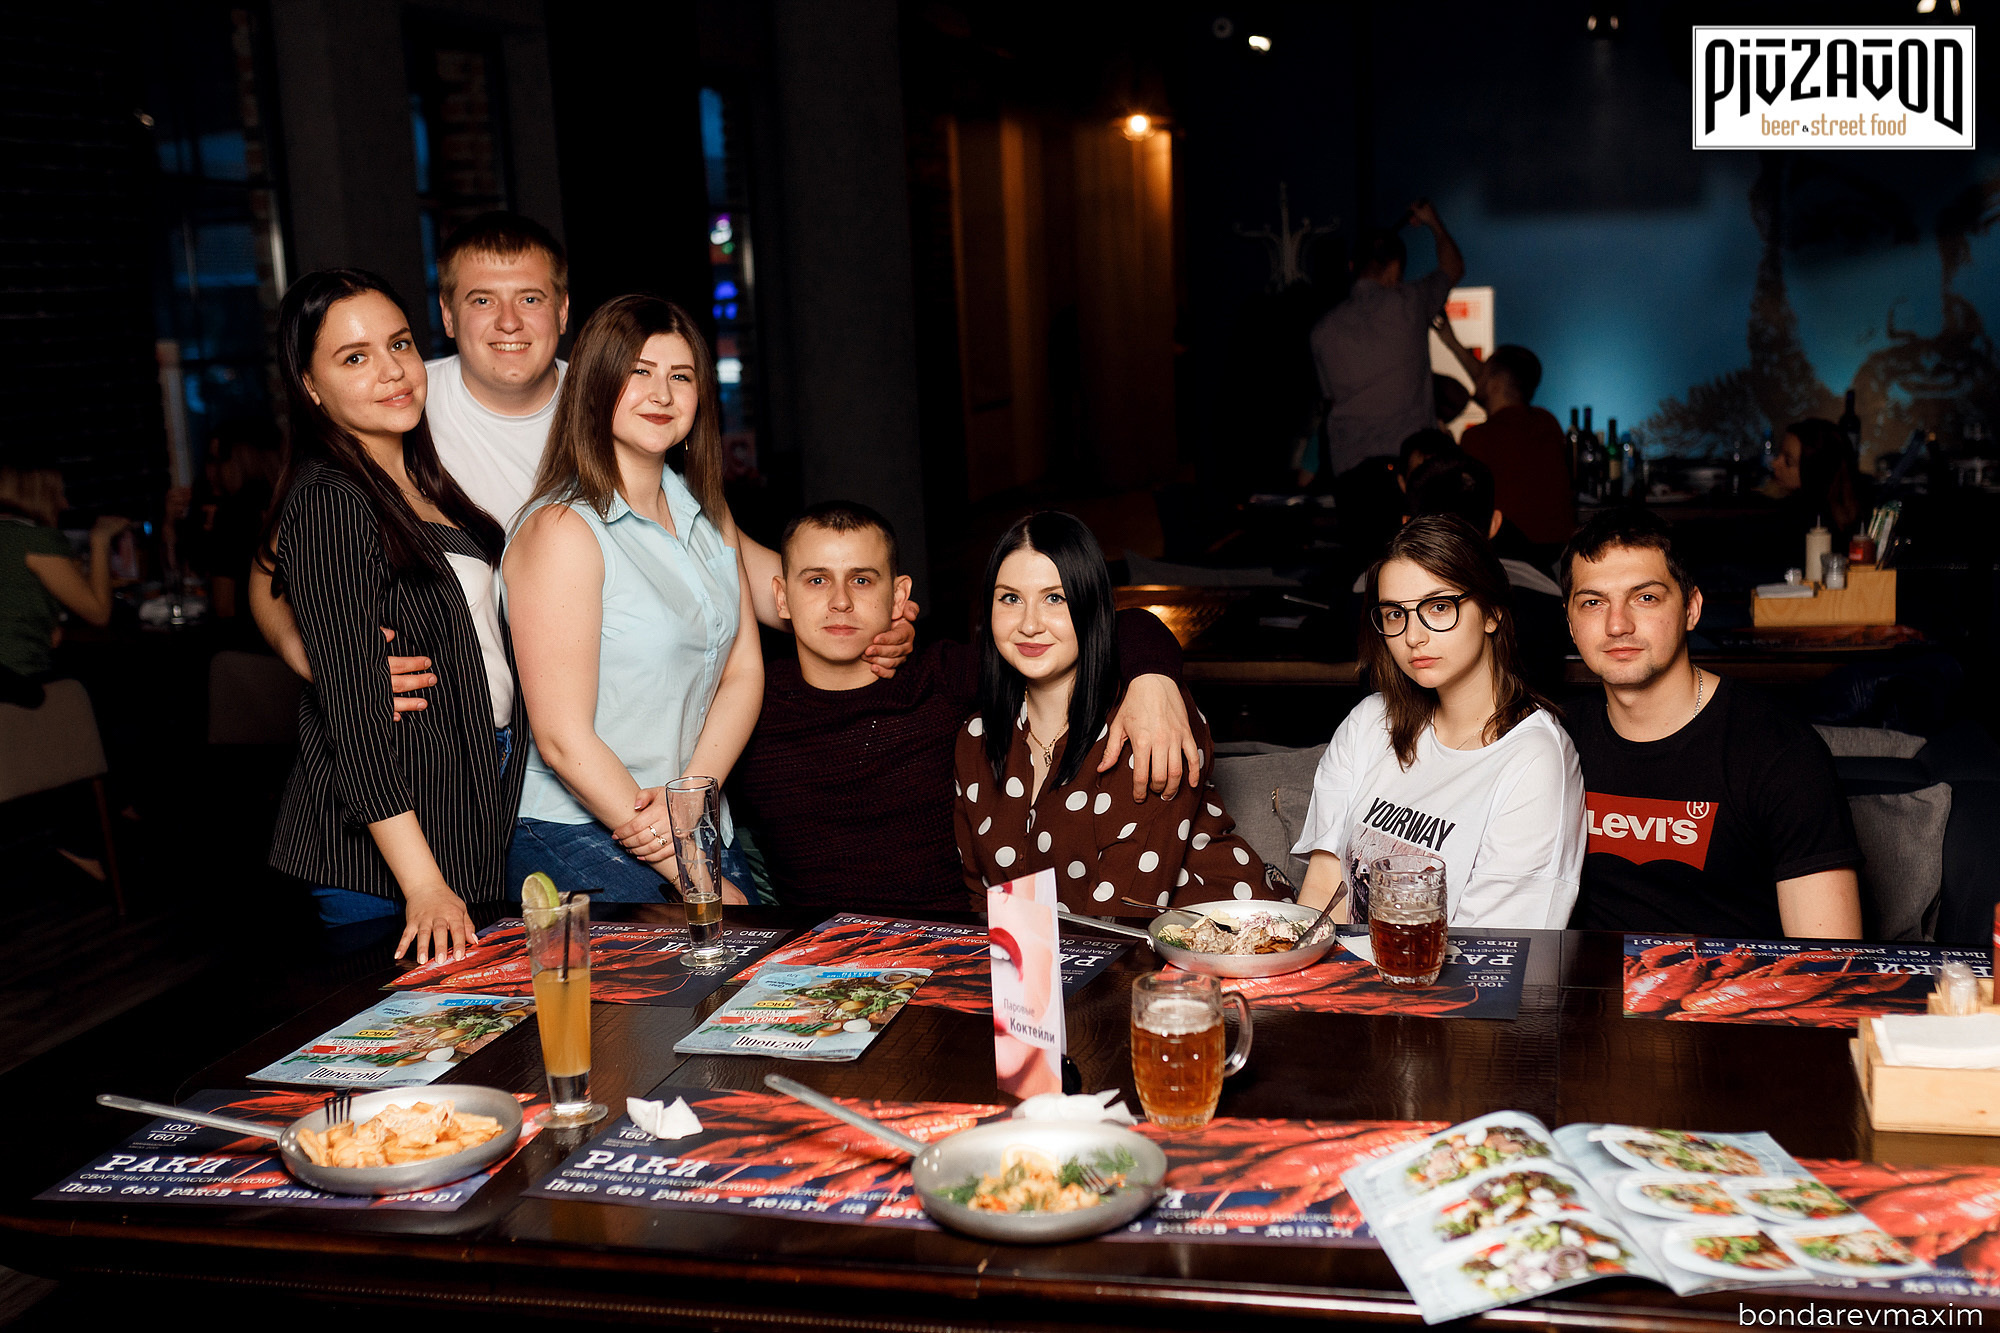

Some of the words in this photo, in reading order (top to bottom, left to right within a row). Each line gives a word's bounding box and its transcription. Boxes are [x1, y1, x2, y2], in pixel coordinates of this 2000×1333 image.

[1362, 797, 1457, 852] YOURWAY
[918, 925, 973, 936] деньги
[1476, 940, 1518, 948] Пиво
[1633, 938, 1694, 947] ветер!
[1735, 942, 1801, 951] деньги
[1830, 947, 1886, 955] раков
[1897, 949, 1931, 957] без
[1940, 951, 1987, 959] Пиво
[1003, 998, 1036, 1018] Паровые
[1009, 1017, 1056, 1045] Коктейли
[162, 1123, 189, 1132] 100
[619, 1130, 647, 1140] 160
[147, 1133, 175, 1141] 160
[94, 1154, 232, 1174] РАКИ
[574, 1149, 710, 1178] РАКИ
[79, 1173, 142, 1182] СВАРЕНЫ
[167, 1175, 281, 1186] КЛАССИЧЕСКОМУ
[561, 1169, 626, 1182] СВАРЕНЫ
[626, 1175, 648, 1184] ПО
[59, 1182, 112, 1194] Пиво
[120, 1185, 160, 1195] без
[163, 1187, 233, 1197] раков
[544, 1178, 598, 1193] Пиво
[606, 1183, 646, 1197] без
[650, 1189, 720, 1204] раков
[748, 1196, 831, 1212] деньги
[840, 1203, 867, 1214] на
[1154, 1222, 1228, 1235] раков
[1264, 1225, 1354, 1239] деньги
